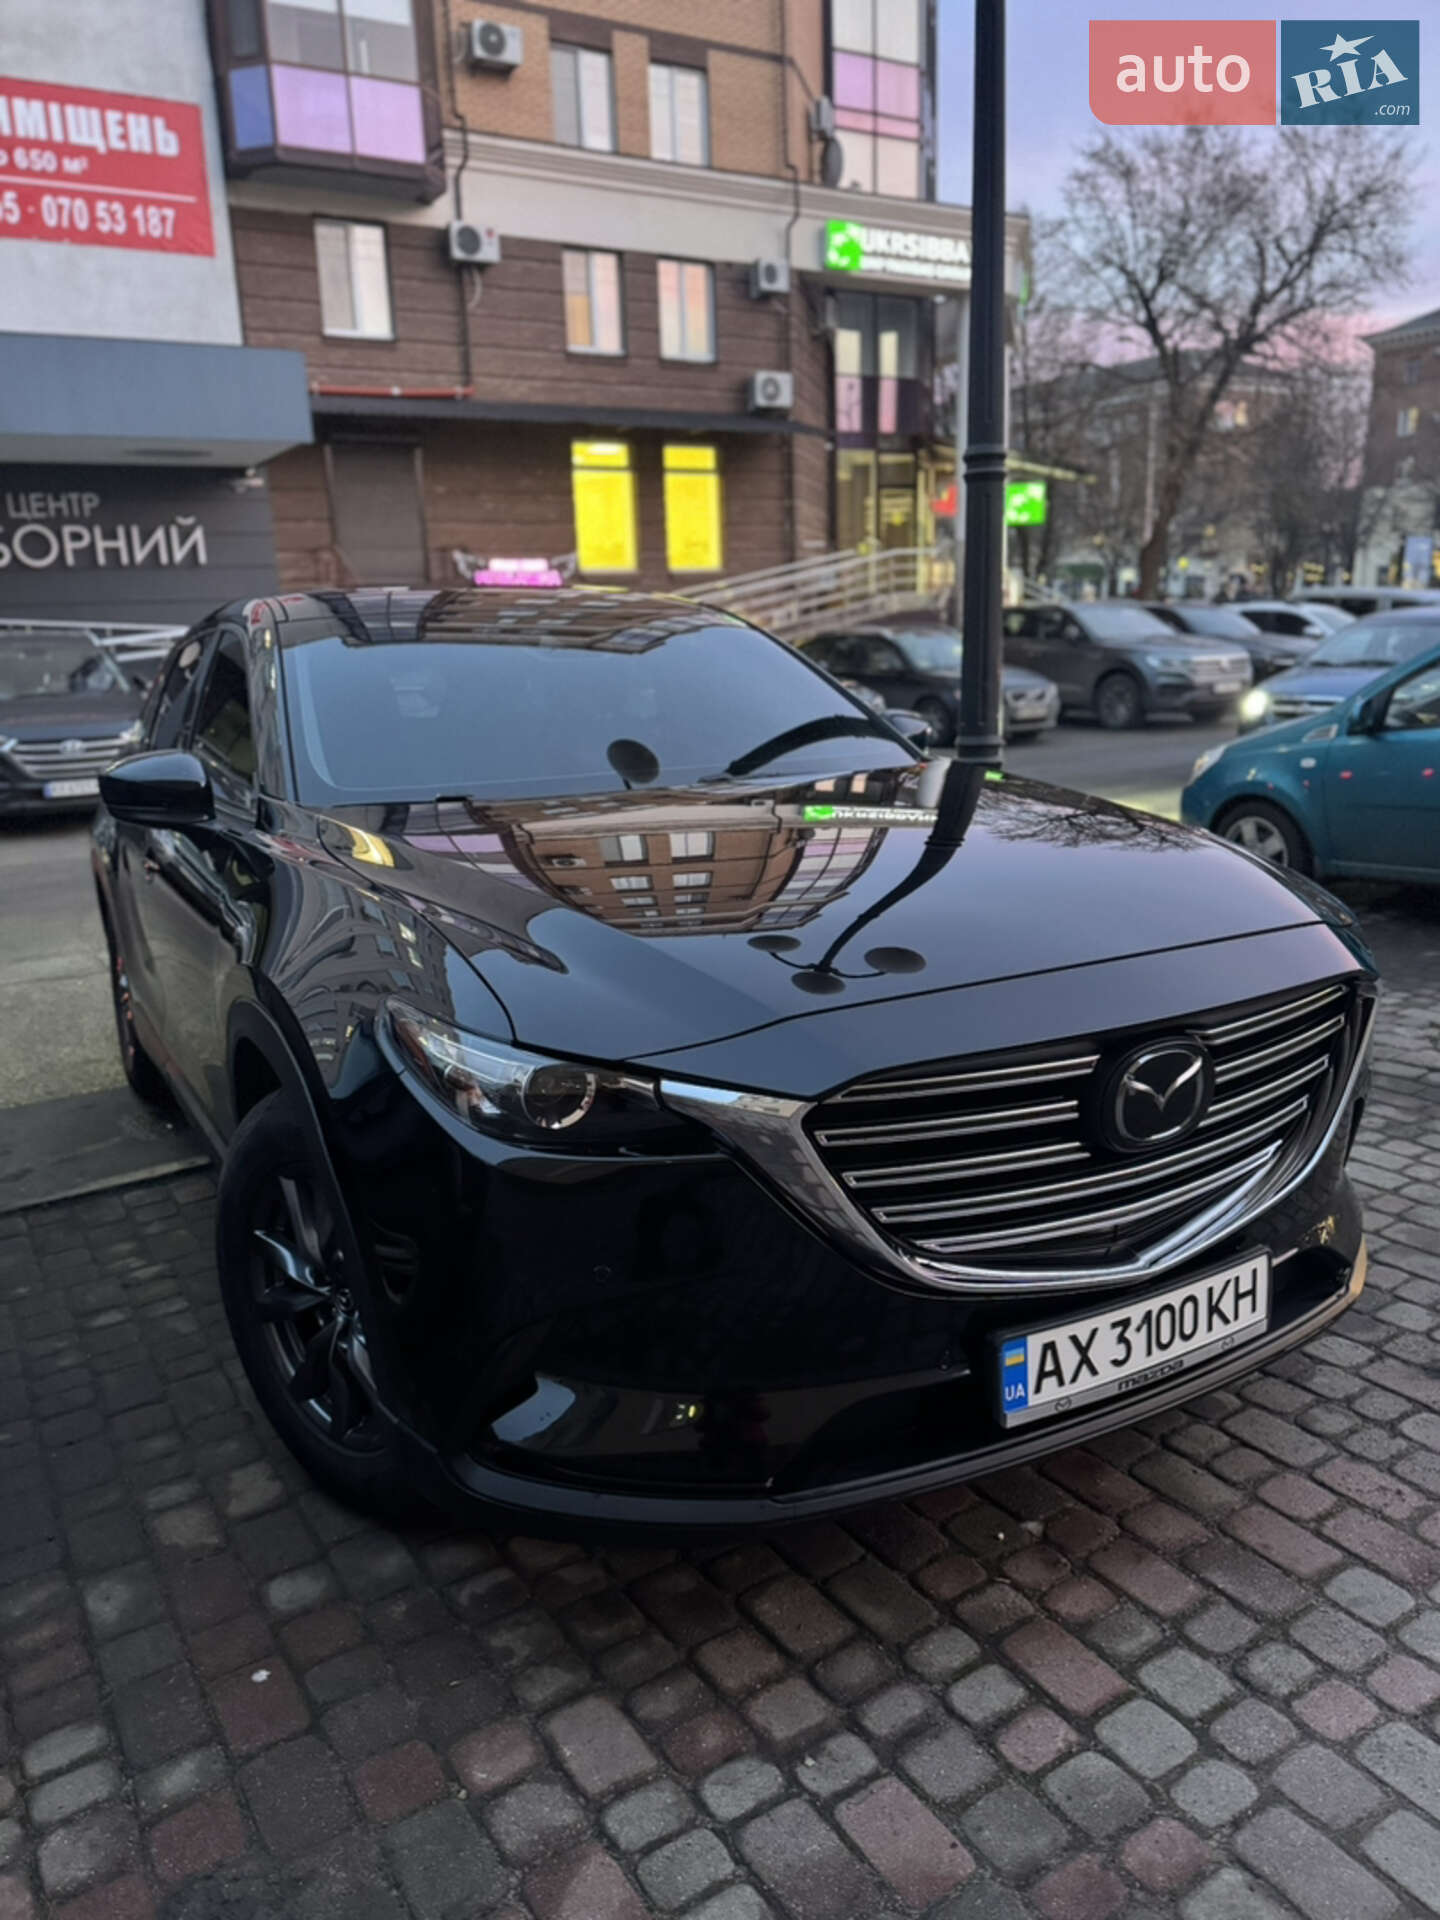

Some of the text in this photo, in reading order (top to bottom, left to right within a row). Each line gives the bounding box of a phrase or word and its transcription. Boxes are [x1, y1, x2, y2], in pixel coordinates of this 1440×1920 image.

[13, 147, 58, 173] 650
[0, 191, 176, 238] 5 070 53 187
[6, 492, 100, 520] ЦЕНТР
[1033, 1267, 1258, 1395] AX 3100 KH
[1004, 1383, 1026, 1401] UA
